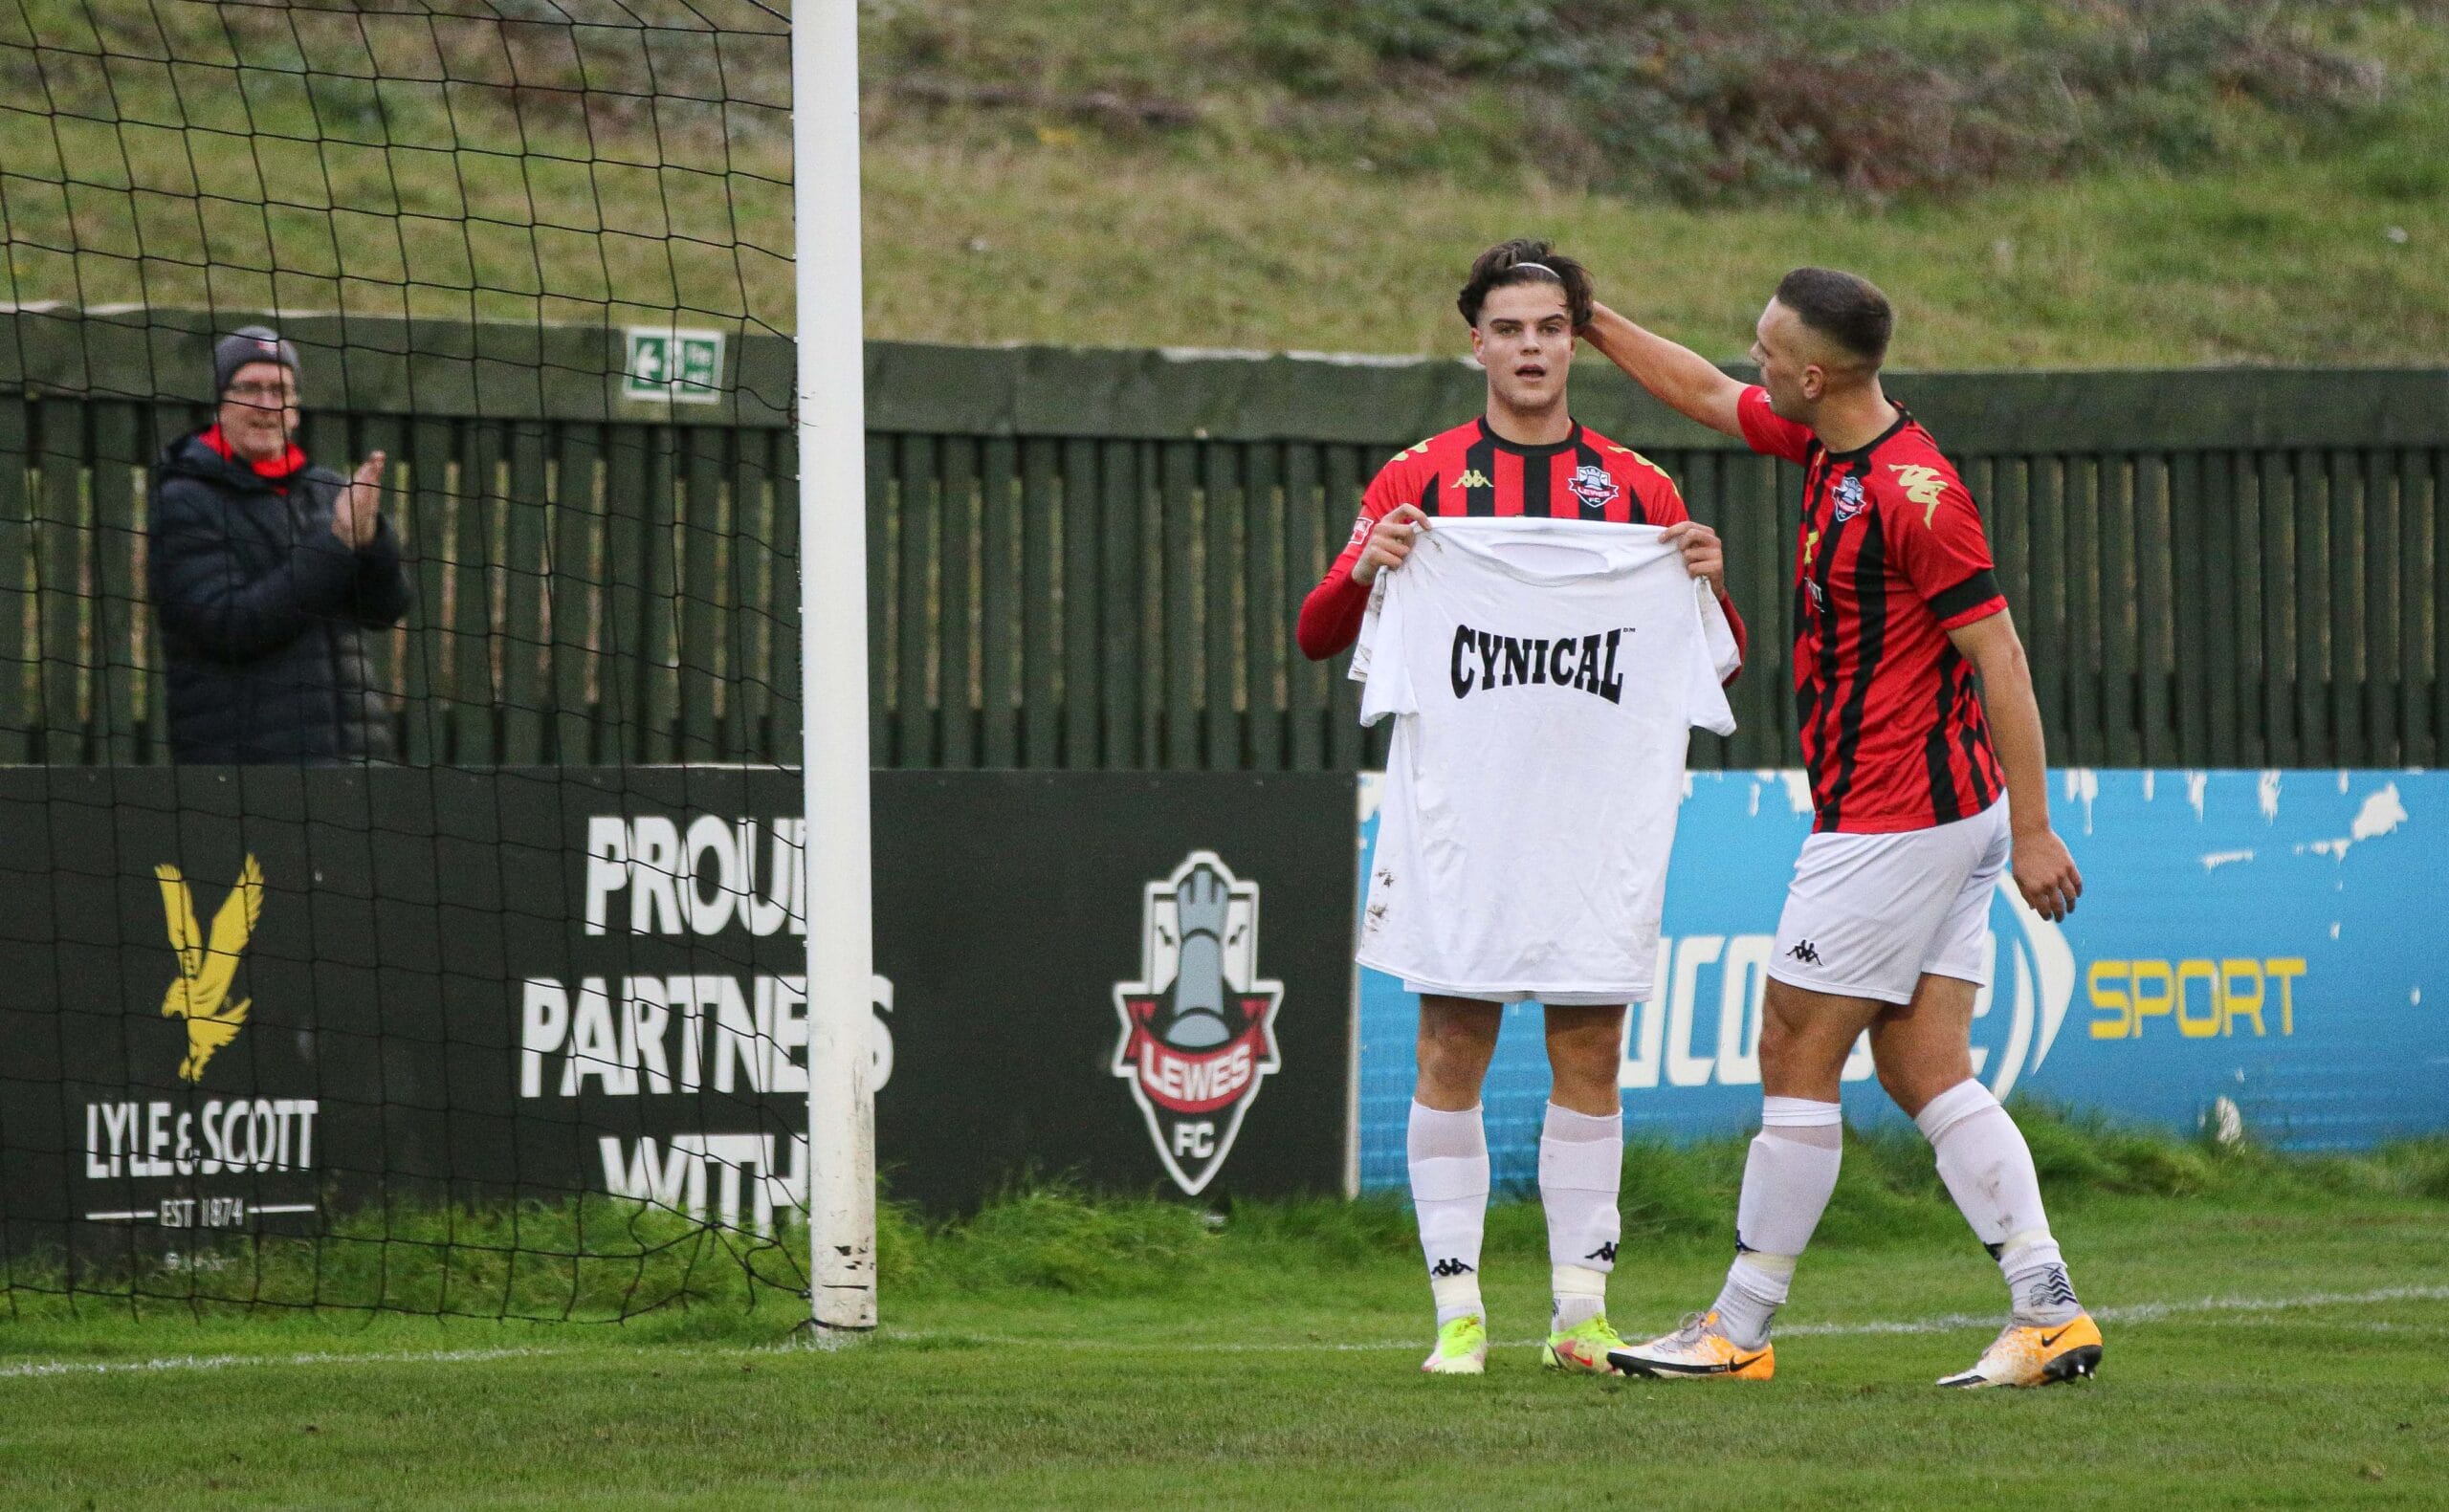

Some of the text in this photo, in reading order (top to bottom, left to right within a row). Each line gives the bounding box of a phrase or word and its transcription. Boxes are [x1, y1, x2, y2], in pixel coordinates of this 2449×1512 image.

[1451, 624, 1623, 705] CYNICAL
[521, 974, 894, 1098] PARTNES
[2087, 958, 2306, 1040] SPORT
[1141, 1041, 1251, 1102] LEWES
[86, 1102, 174, 1179] LYLE
[202, 1100, 319, 1175] SCOTT
[1174, 1121, 1215, 1159] FC
[161, 1198, 243, 1228] EST 1874
